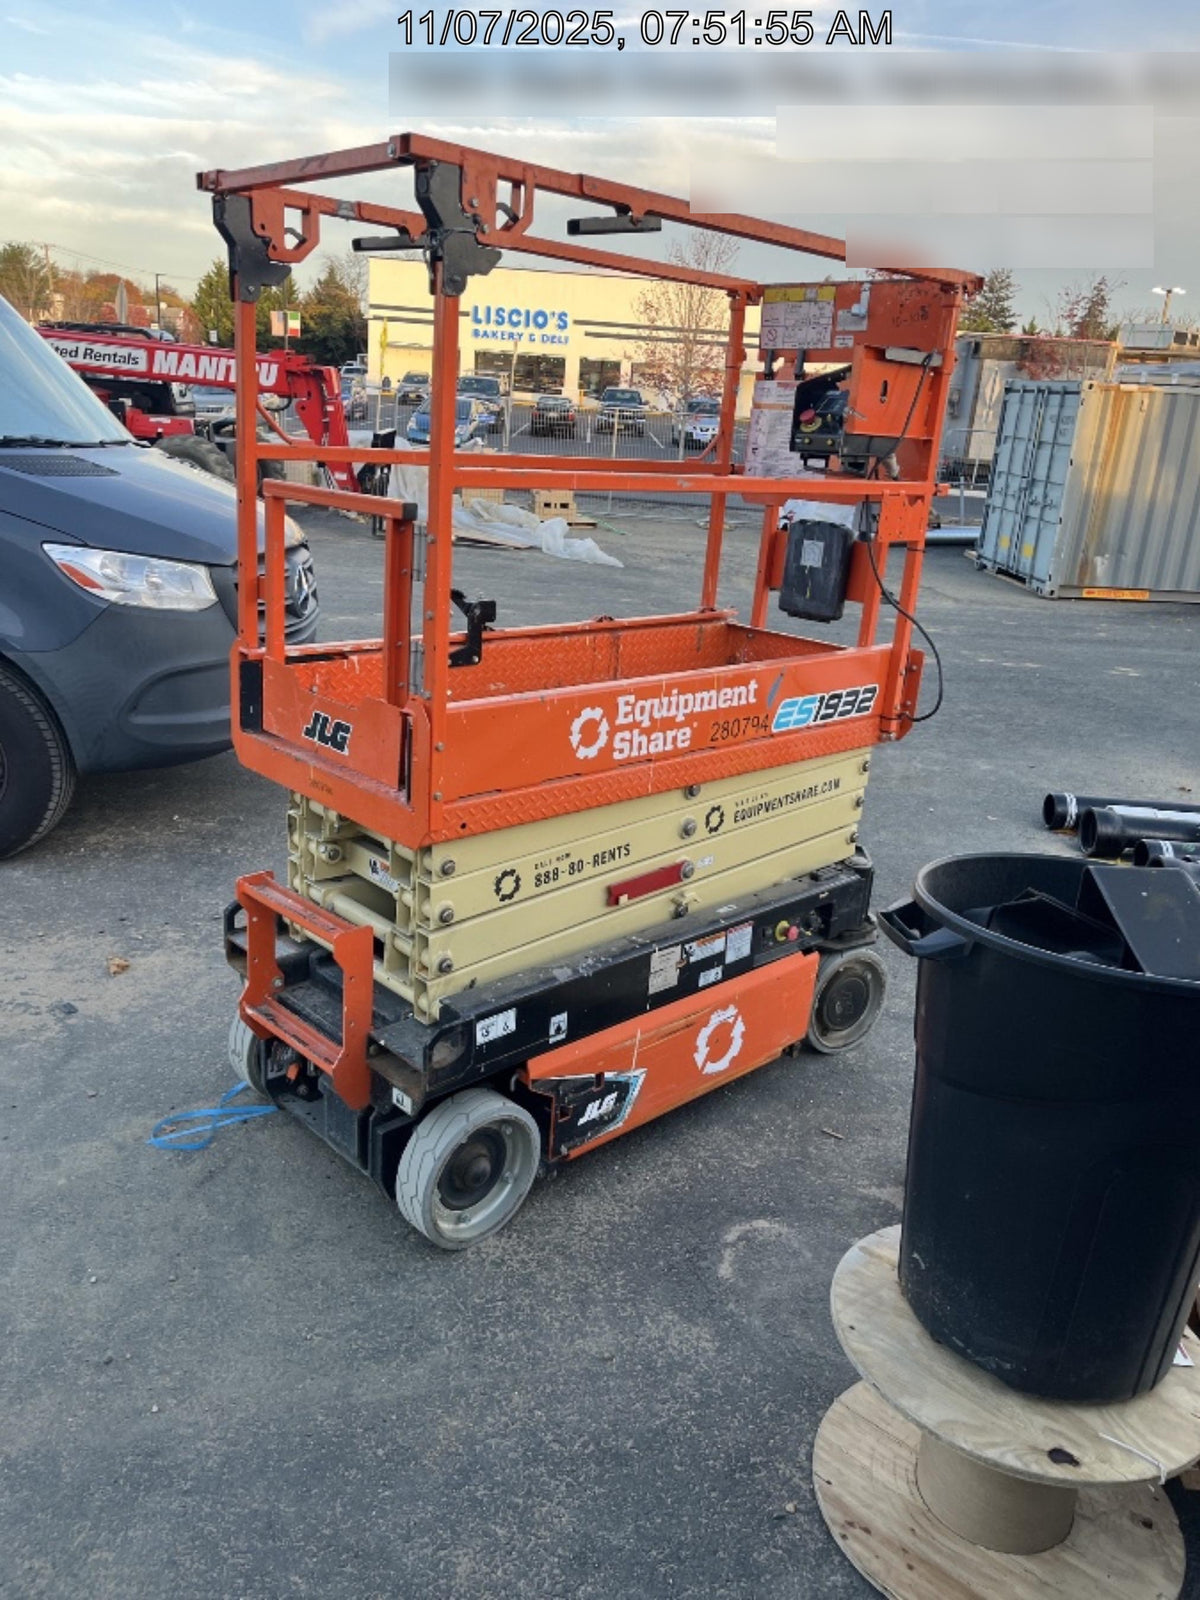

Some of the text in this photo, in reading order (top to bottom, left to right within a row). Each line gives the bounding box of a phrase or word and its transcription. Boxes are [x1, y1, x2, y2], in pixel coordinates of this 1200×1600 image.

[472, 305, 569, 331] LISCIO'S
[472, 328, 524, 342] BAKERY
[541, 334, 569, 345] DELI
[52, 343, 140, 365] ted Rentals
[152, 350, 280, 387] MANITU
[615, 679, 759, 728] Equipment
[771, 684, 879, 732] ES1932
[302, 710, 353, 756] JLG
[613, 725, 693, 760] Share
[709, 714, 769, 742] 280794
[733, 777, 841, 824] EQUIPMENTSHARE.COM
[534, 843, 631, 888] 888-80-RENTS
